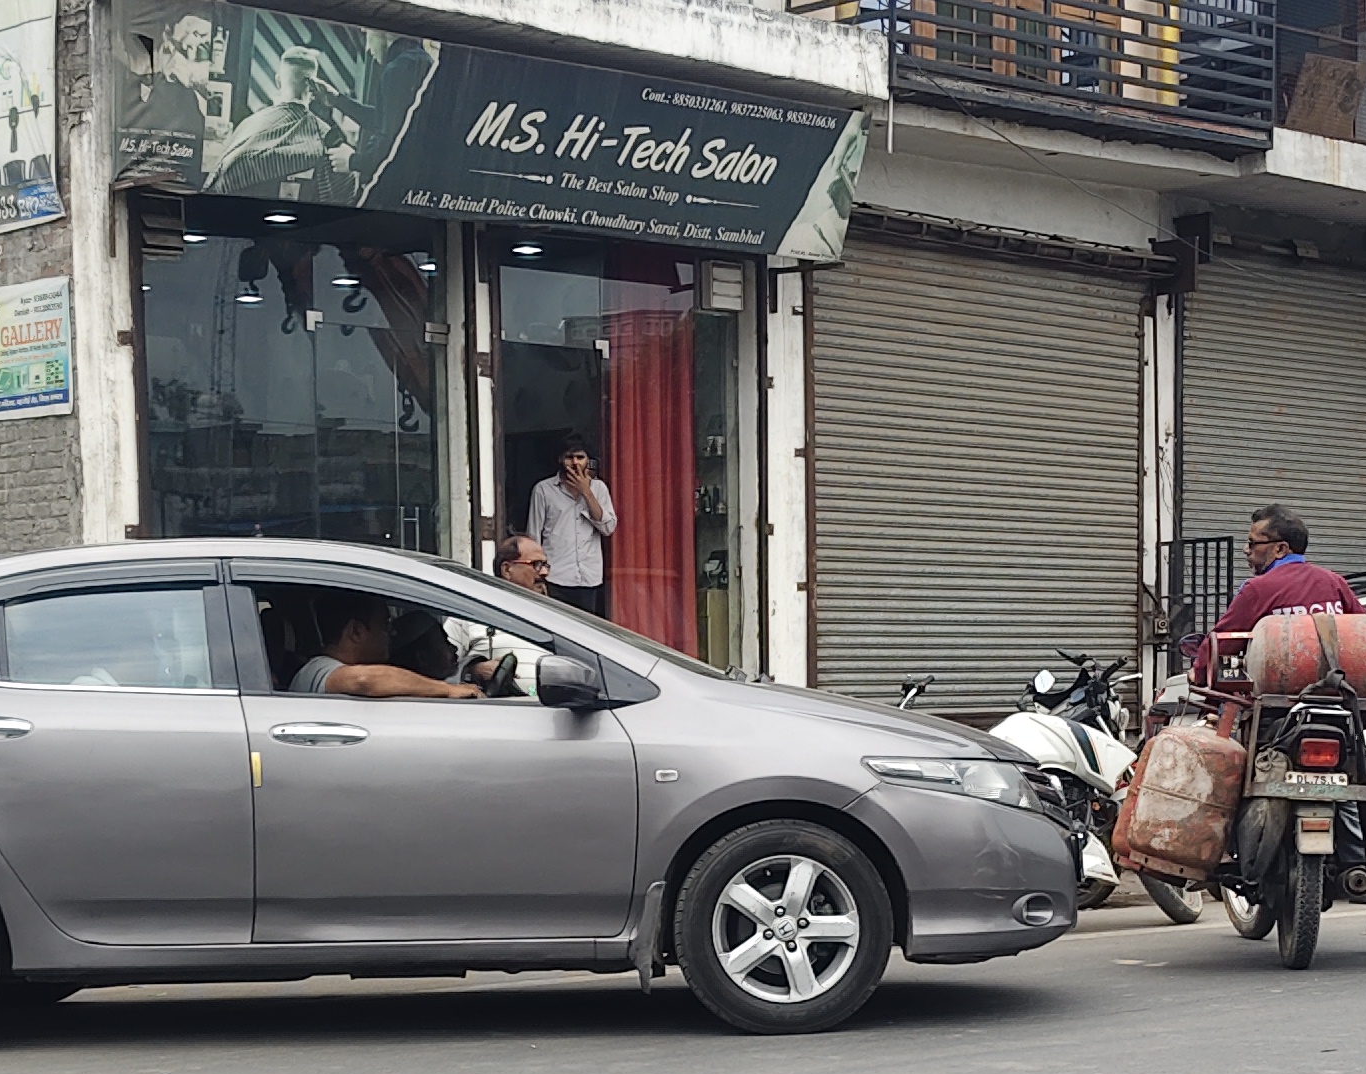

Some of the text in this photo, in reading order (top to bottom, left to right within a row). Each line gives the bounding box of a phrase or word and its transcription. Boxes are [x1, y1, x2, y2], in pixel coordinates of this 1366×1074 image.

[672, 92, 728, 115] 8850331261,
[119, 138, 137, 152] M.S.
[171, 142, 194, 158] Salon
[465, 101, 779, 185] M.S. Hi-Tech Salon
[560, 171, 680, 204] The Best Salon Shop
[402, 189, 437, 208] Add.:
[439, 193, 486, 213] Behind
[487, 198, 526, 217] Police
[529, 203, 578, 225] Chowki,
[581, 210, 646, 235] Choudhary
[647, 218, 681, 239] Sarai,
[715, 227, 766, 246] Sambhal
[0, 318, 63, 348] GALLERY
